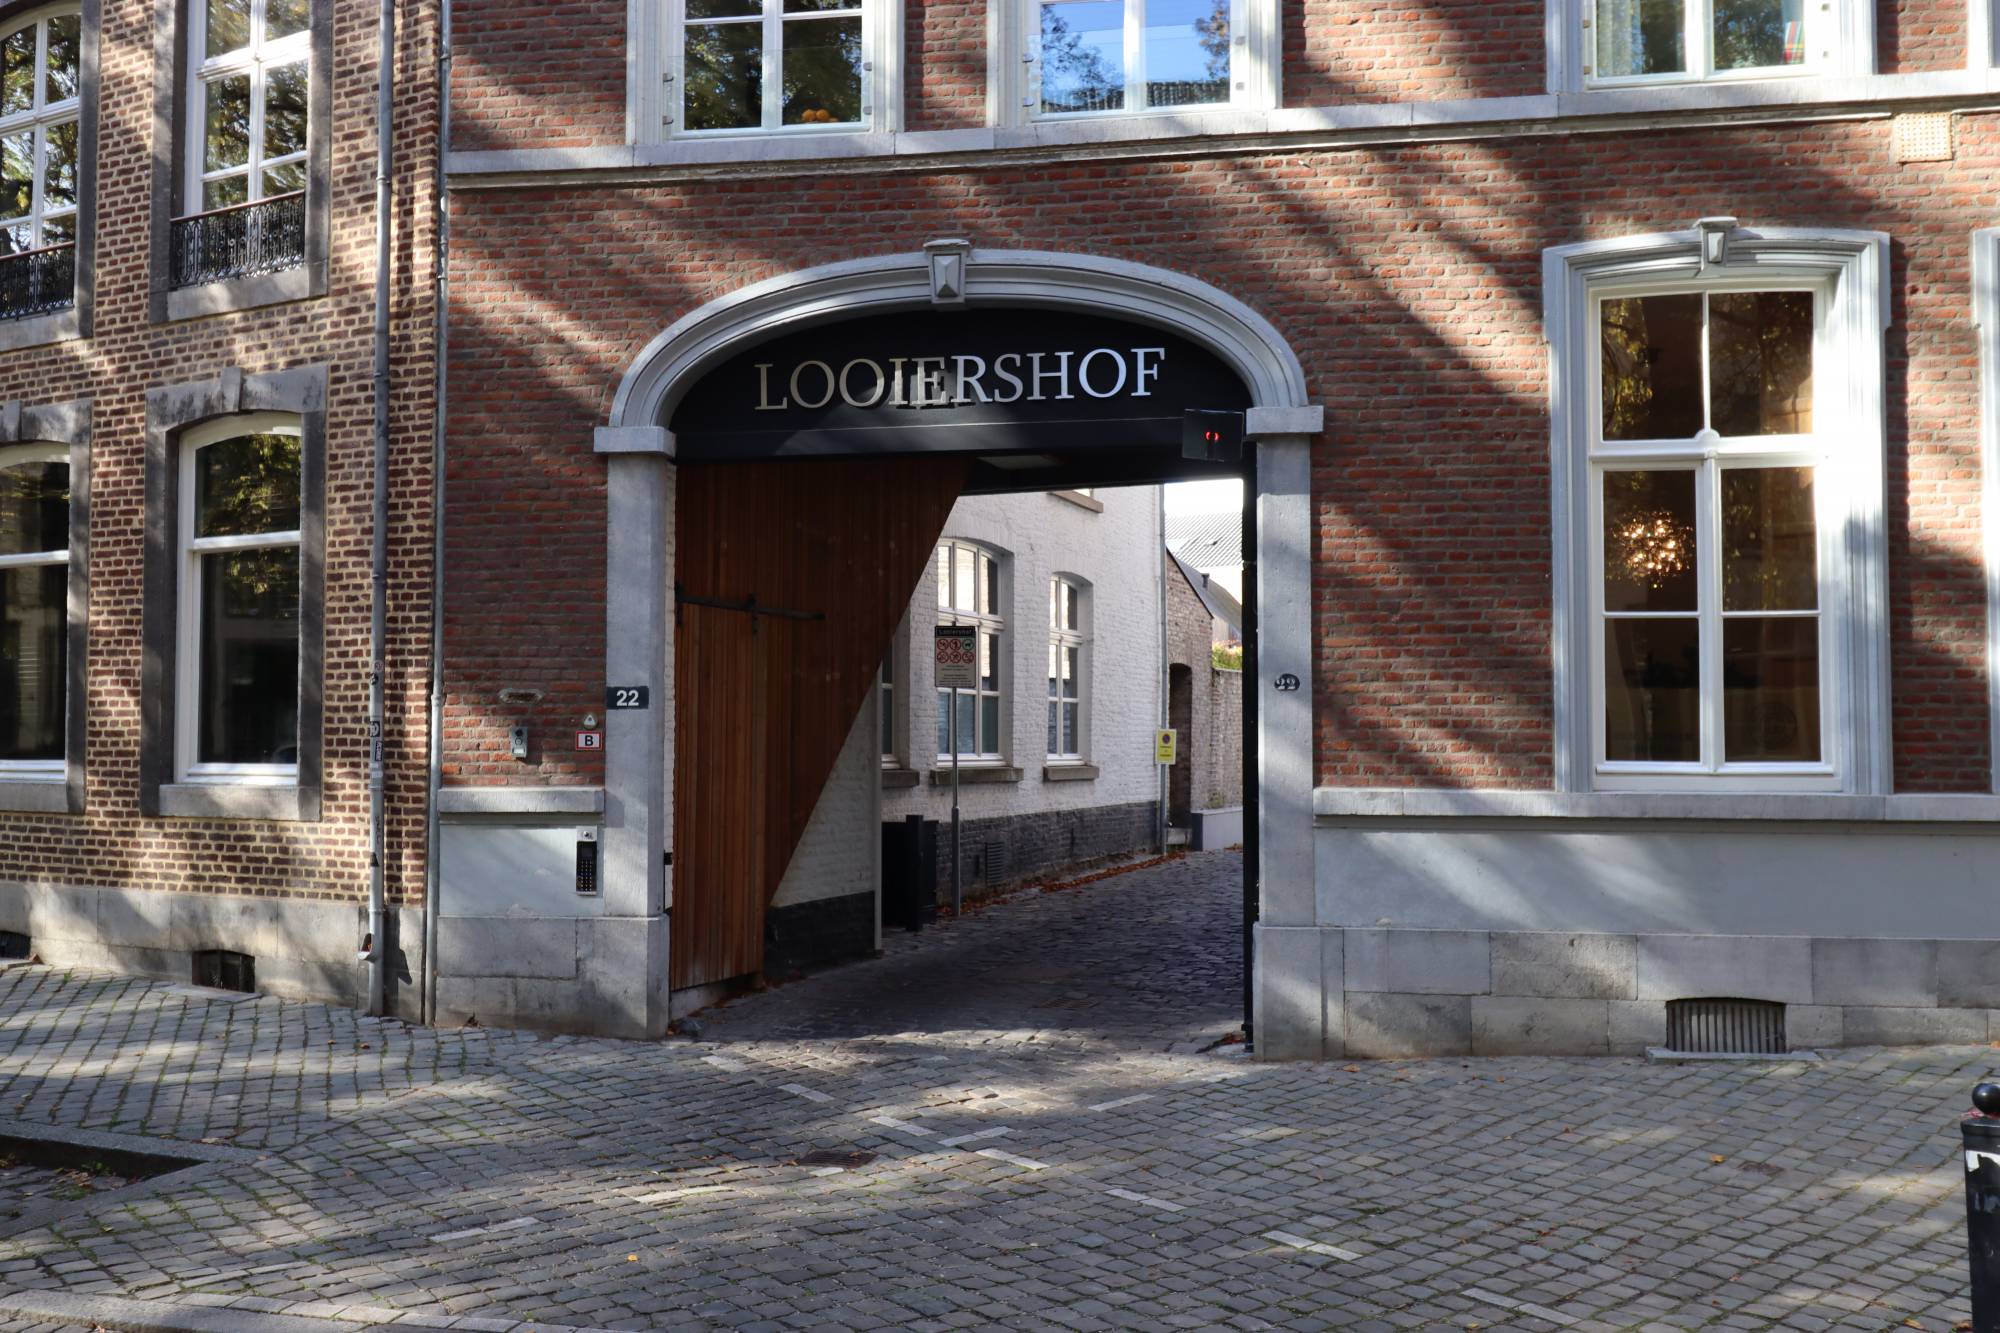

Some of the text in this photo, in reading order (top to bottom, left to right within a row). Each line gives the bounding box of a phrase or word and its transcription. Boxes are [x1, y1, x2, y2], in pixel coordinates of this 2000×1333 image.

[753, 347, 1166, 411] LOOIERSHOF
[1275, 678, 1296, 690] 22
[616, 690, 639, 707] 22
[584, 735, 594, 747] B
